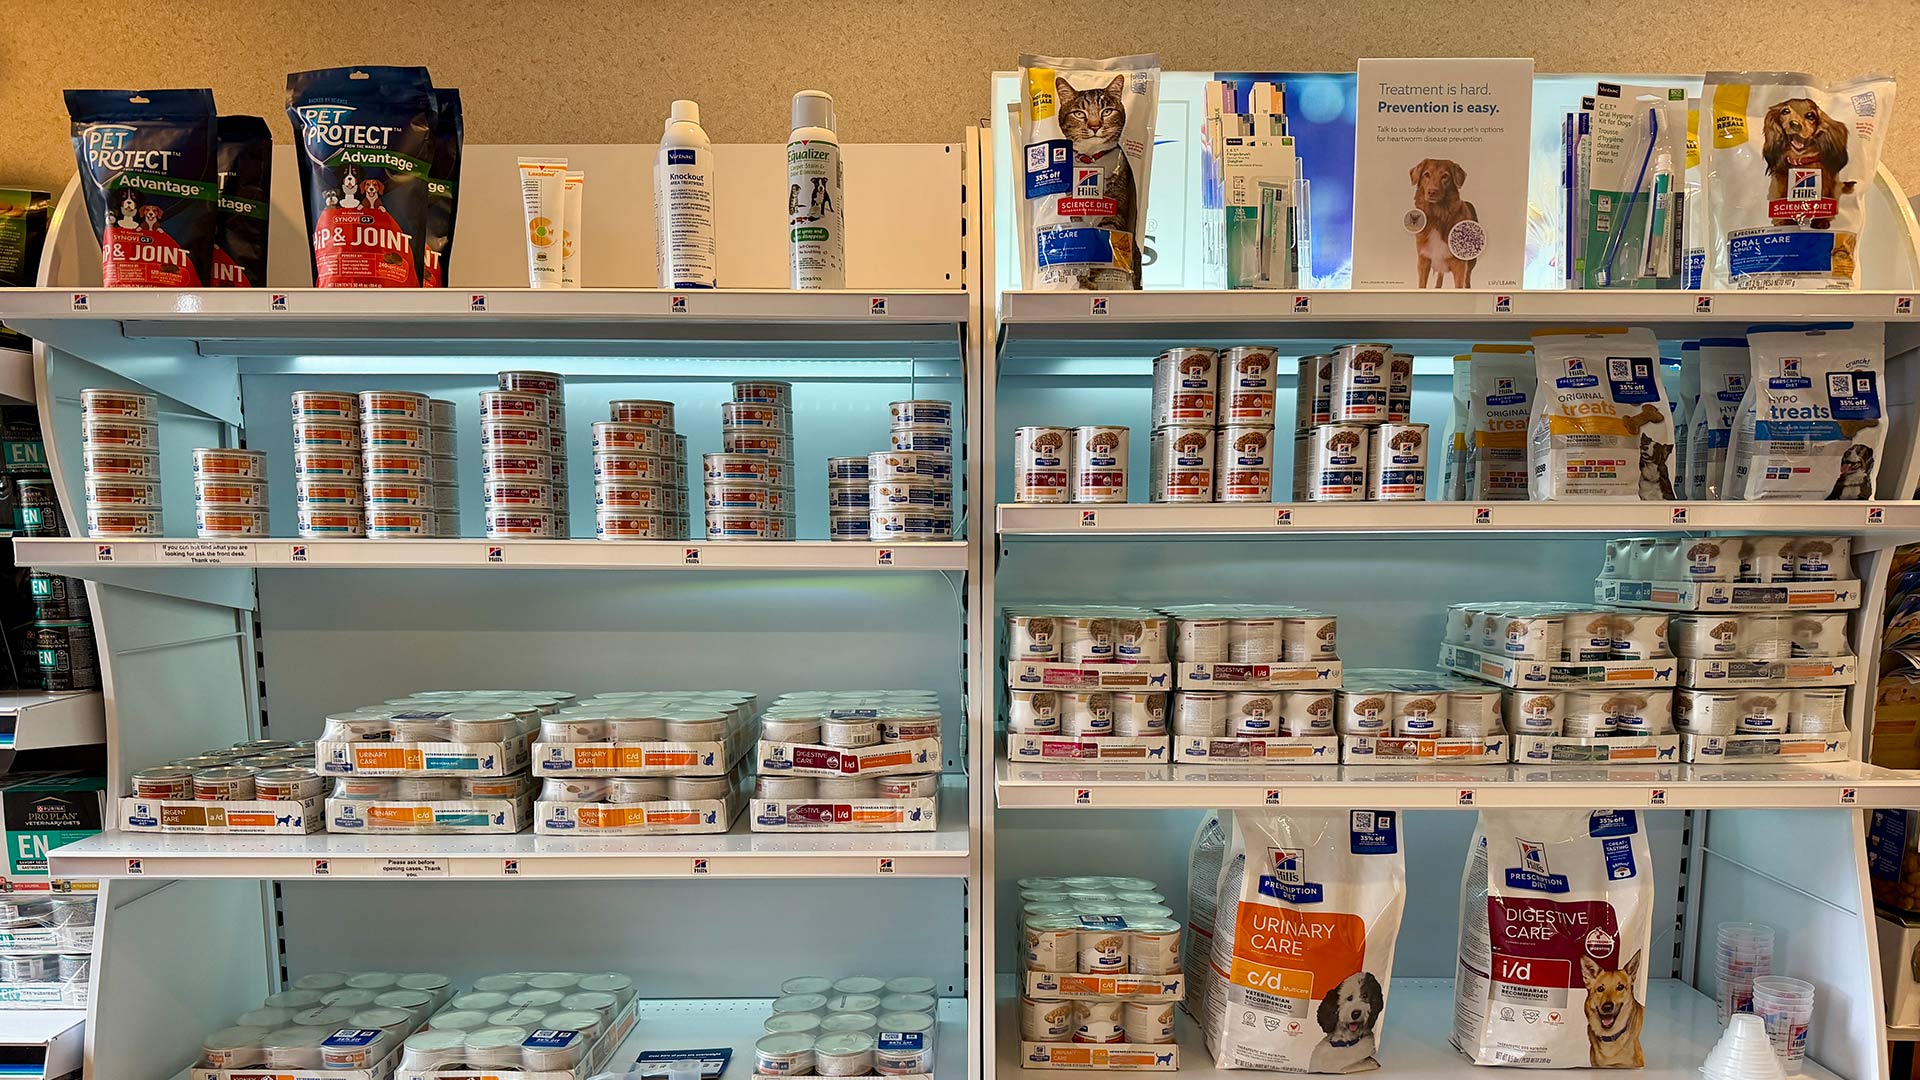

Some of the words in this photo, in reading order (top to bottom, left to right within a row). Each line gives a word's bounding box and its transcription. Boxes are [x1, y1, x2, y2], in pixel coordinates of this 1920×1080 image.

[1378, 82, 1444, 96] Treatment
[1447, 82, 1457, 96] is
[1461, 82, 1491, 96] hard.
[1378, 101, 1449, 113] Prevention
[1453, 101, 1463, 113] is
[1467, 103, 1500, 116] easy.
[305, 110, 347, 125] PET
[1599, 110, 1611, 118] Oral
[1612, 111, 1634, 121] Hygiene
[1716, 116, 1730, 124] NOT
[1617, 120, 1632, 128] Dogs
[1716, 121, 1745, 131] RESALE
[1408, 126, 1427, 135] today
[1463, 126, 1479, 135] pet's
[1480, 127, 1504, 135] options
[1598, 127, 1619, 136] Trousse
[90, 132, 128, 150] PET
[1376, 135, 1386, 143] for
[1386, 135, 1423, 143] heartworm
[1424, 135, 1448, 143] disease
[1449, 136, 1484, 144] prevention.
[1597, 142, 1620, 150] dentaire
[1596, 150, 1612, 158] pour
[670, 173, 704, 181] Knockout
[1078, 185, 1099, 196] Hill's
[1792, 189, 1818, 199] Hill's
[1062, 201, 1095, 210] SCIENCE
[1097, 201, 1114, 210] DIET
[1059, 231, 1078, 240] CARE
[1734, 229, 1766, 237] SPECIALTY
[333, 227, 346, 246] &
[351, 227, 412, 254] JOINT
[1733, 238, 1760, 248] ORAL
[1763, 235, 1791, 245] CARE
[113, 243, 125, 261] &
[129, 245, 189, 267] JOINT
[1558, 392, 1604, 403] ORIGINAL
[1768, 395, 1798, 404] HYPO
[1561, 400, 1617, 417] treats
[1770, 404, 1830, 420] treats
[1488, 418, 1529, 430] trea
[11, 444, 38, 462] EN
[23, 509, 38, 523] EN
[31, 581, 47, 594] EN
[40, 651, 52, 664] EN
[407, 755, 420, 763] c/d
[796, 751, 828, 759] DIGESTIVE
[844, 760, 855, 768] i/d
[29, 813, 48, 821] PRO
[18, 835, 48, 858] EN
[1606, 844, 1629, 852] TASTING
[1527, 859, 1545, 874] Hill's
[1276, 868, 1299, 882] Hill's
[1510, 873, 1562, 887] PRESCRIPTION
[1265, 881, 1317, 895] PRESCRIPTION
[1531, 881, 1547, 890] DIET
[1283, 891, 1296, 901] DIET
[1506, 908, 1589, 926] DIGESTIVE
[1253, 914, 1335, 940] URINARY
[1505, 925, 1551, 940] CARE
[1251, 934, 1303, 956] CARE
[1502, 960, 1531, 981] i/d
[1247, 970, 1282, 991] c/d
[1282, 986, 1309, 994] Multicare
[1501, 984, 1549, 994] VETERINARIAN
[1501, 990, 1549, 999] RECOMMENDED
[1245, 989, 1290, 1004] VETERINARIAN
[1245, 995, 1292, 1010] RECOMMENDED
